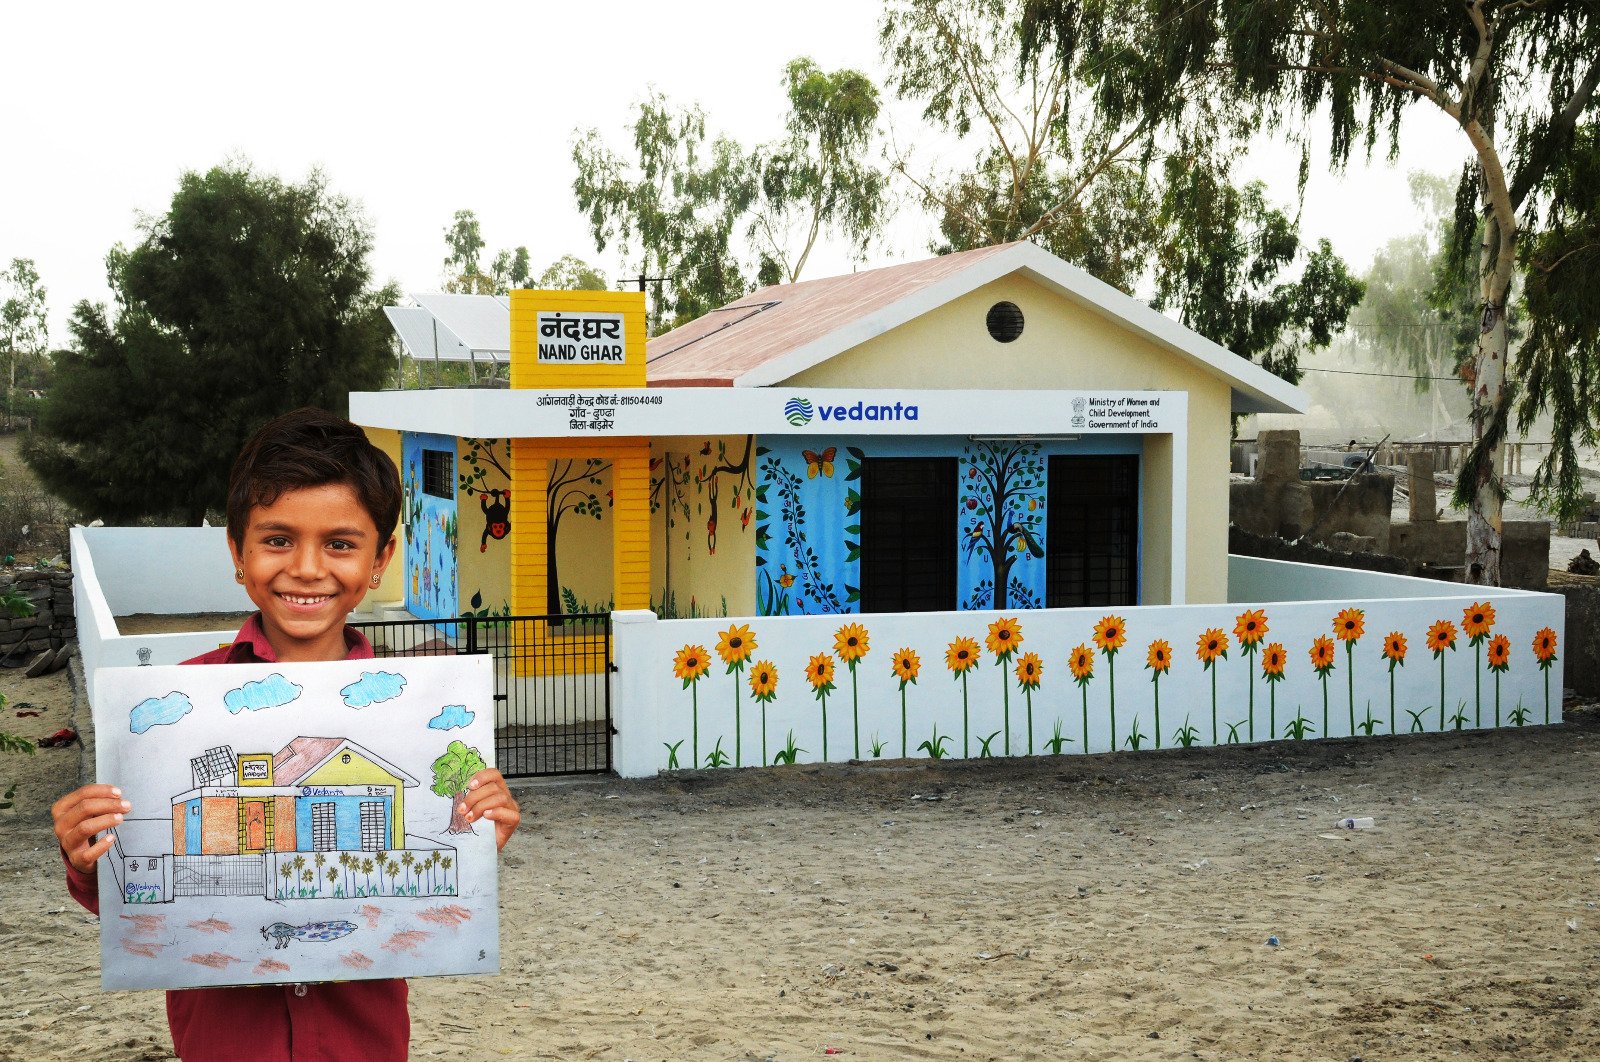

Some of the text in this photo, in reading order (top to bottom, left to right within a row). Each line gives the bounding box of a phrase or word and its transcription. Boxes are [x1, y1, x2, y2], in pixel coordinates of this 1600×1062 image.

[538, 344, 622, 361] NAND GHAR
[1089, 398, 1160, 408] Ministry of Women and
[818, 401, 919, 421] vedanta
[1089, 408, 1150, 419] Child Development
[1088, 420, 1130, 428] Government
[1131, 420, 1139, 428] of
[1140, 420, 1158, 428] India
[135, 882, 161, 891] Vedanta
